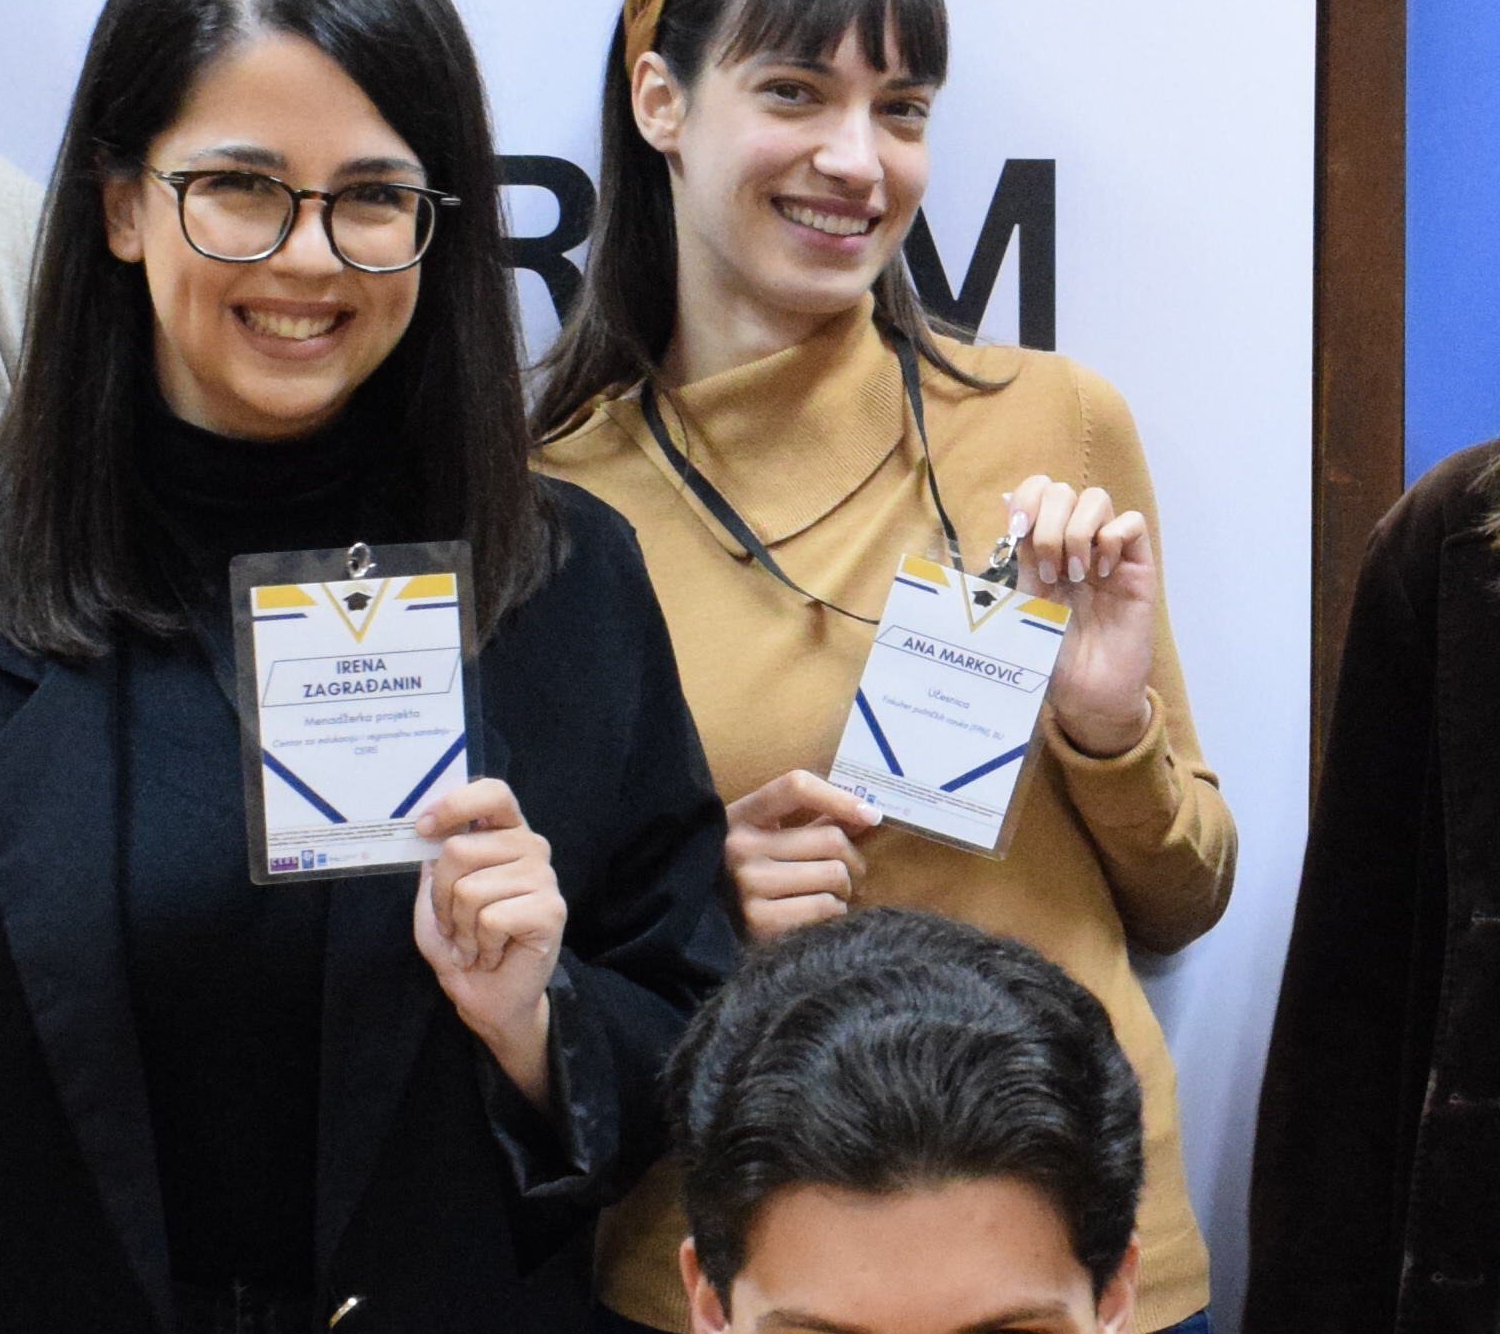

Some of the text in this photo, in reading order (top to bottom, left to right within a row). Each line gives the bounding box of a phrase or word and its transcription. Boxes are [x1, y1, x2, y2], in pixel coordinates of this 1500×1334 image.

[336, 658, 387, 675] IRENA
[903, 636, 1024, 685] ANA MARKOVIĆ
[303, 676, 422, 698] ZAGRAĐANIN
